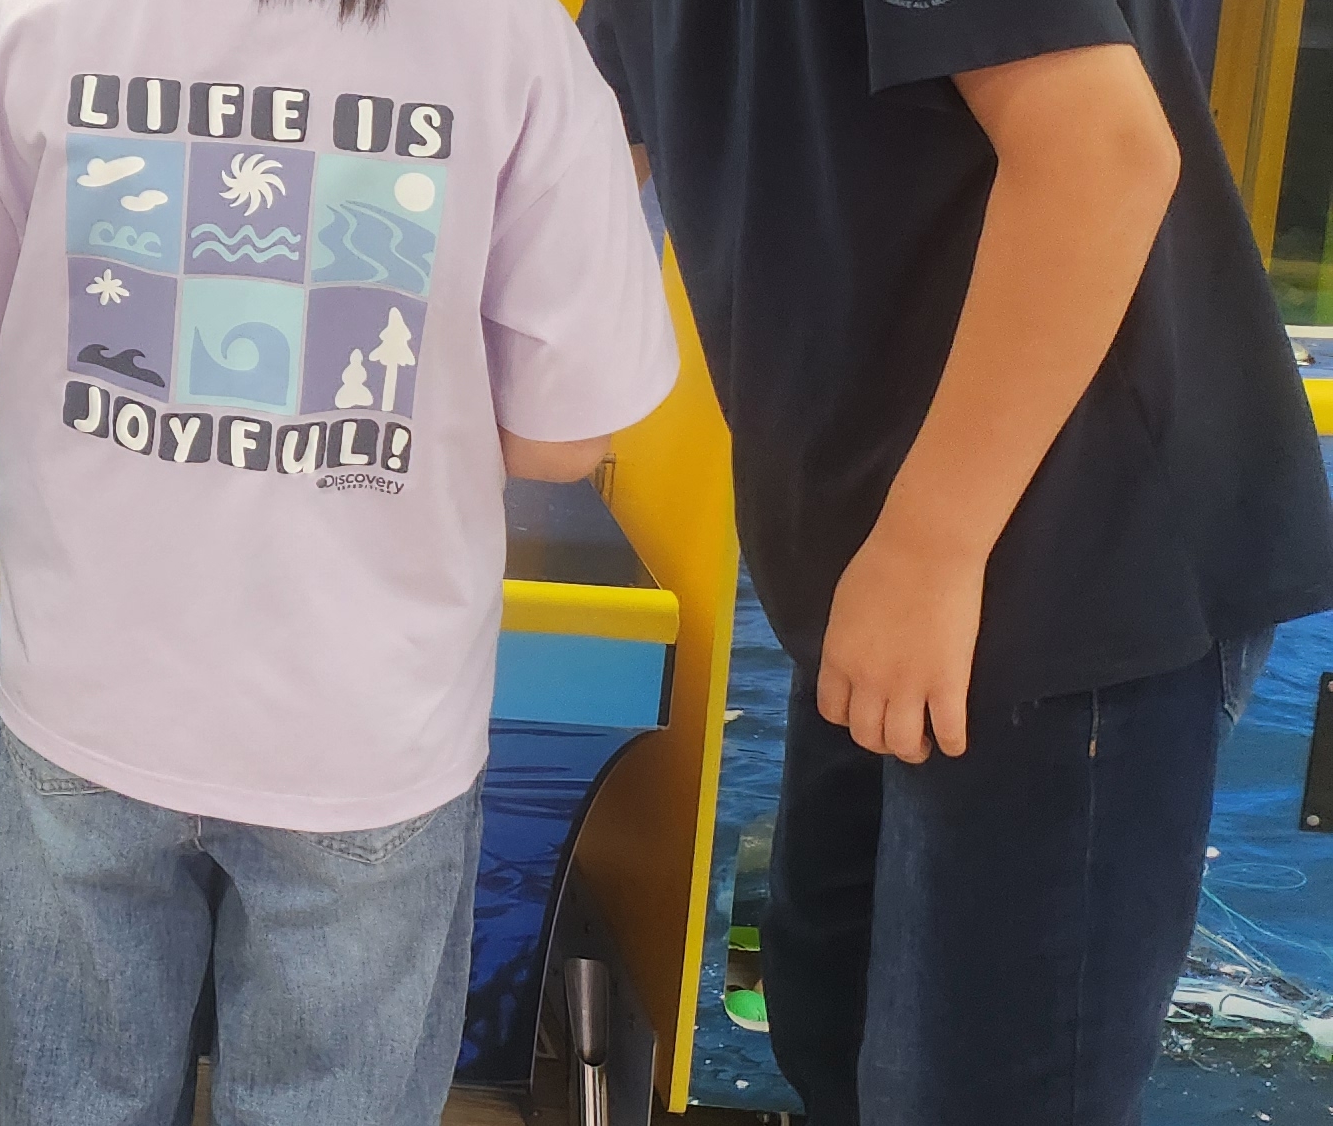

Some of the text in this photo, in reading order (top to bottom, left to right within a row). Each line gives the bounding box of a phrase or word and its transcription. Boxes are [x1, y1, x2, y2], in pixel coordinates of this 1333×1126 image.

[73, 74, 445, 158] LIFE IS
[69, 385, 411, 474] JOYFUL!
